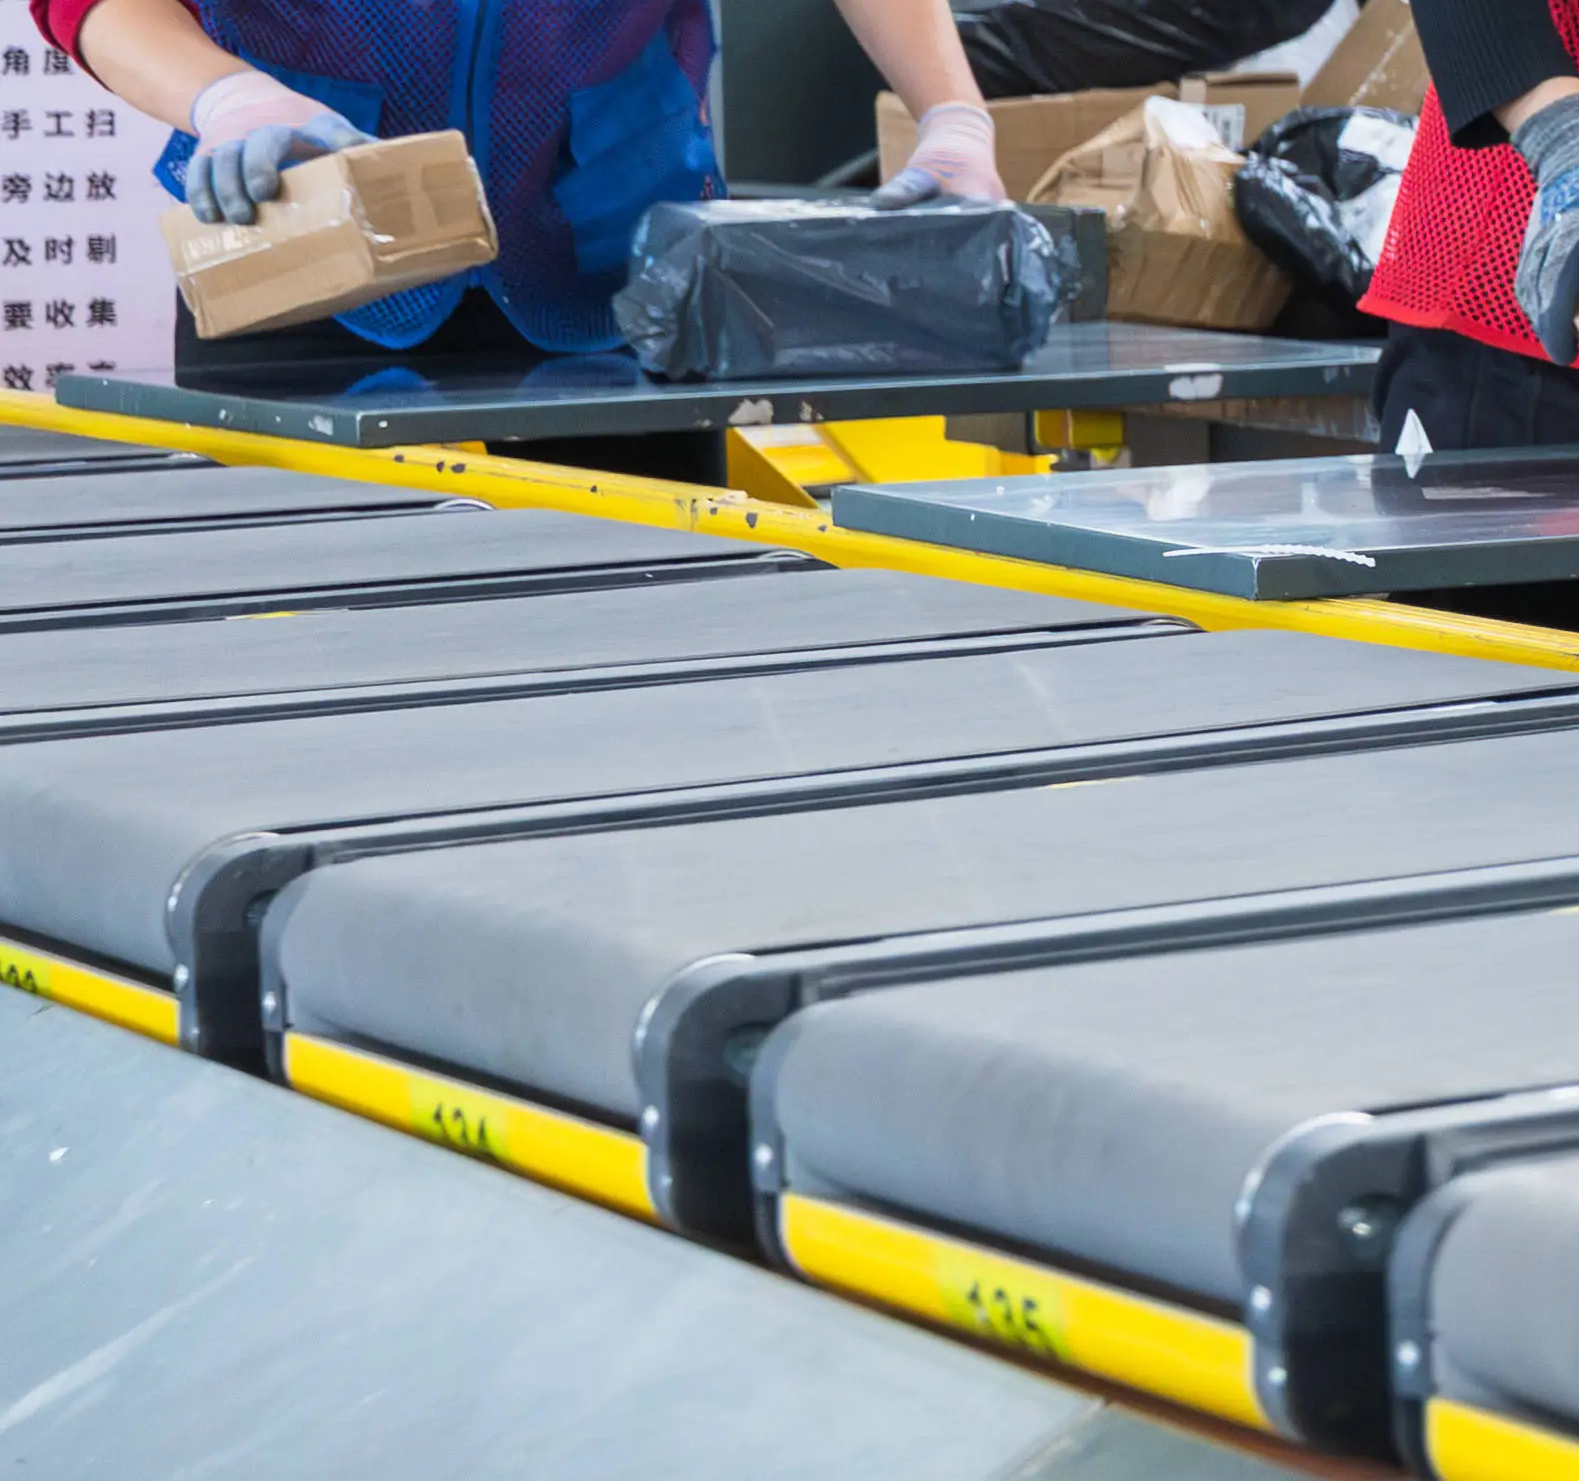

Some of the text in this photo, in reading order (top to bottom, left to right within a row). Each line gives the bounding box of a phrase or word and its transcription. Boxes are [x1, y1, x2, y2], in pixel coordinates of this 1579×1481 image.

[2, 108, 116, 140] 手工扫
[2, 170, 117, 204] 旁边放
[3, 297, 118, 330] 要收集
